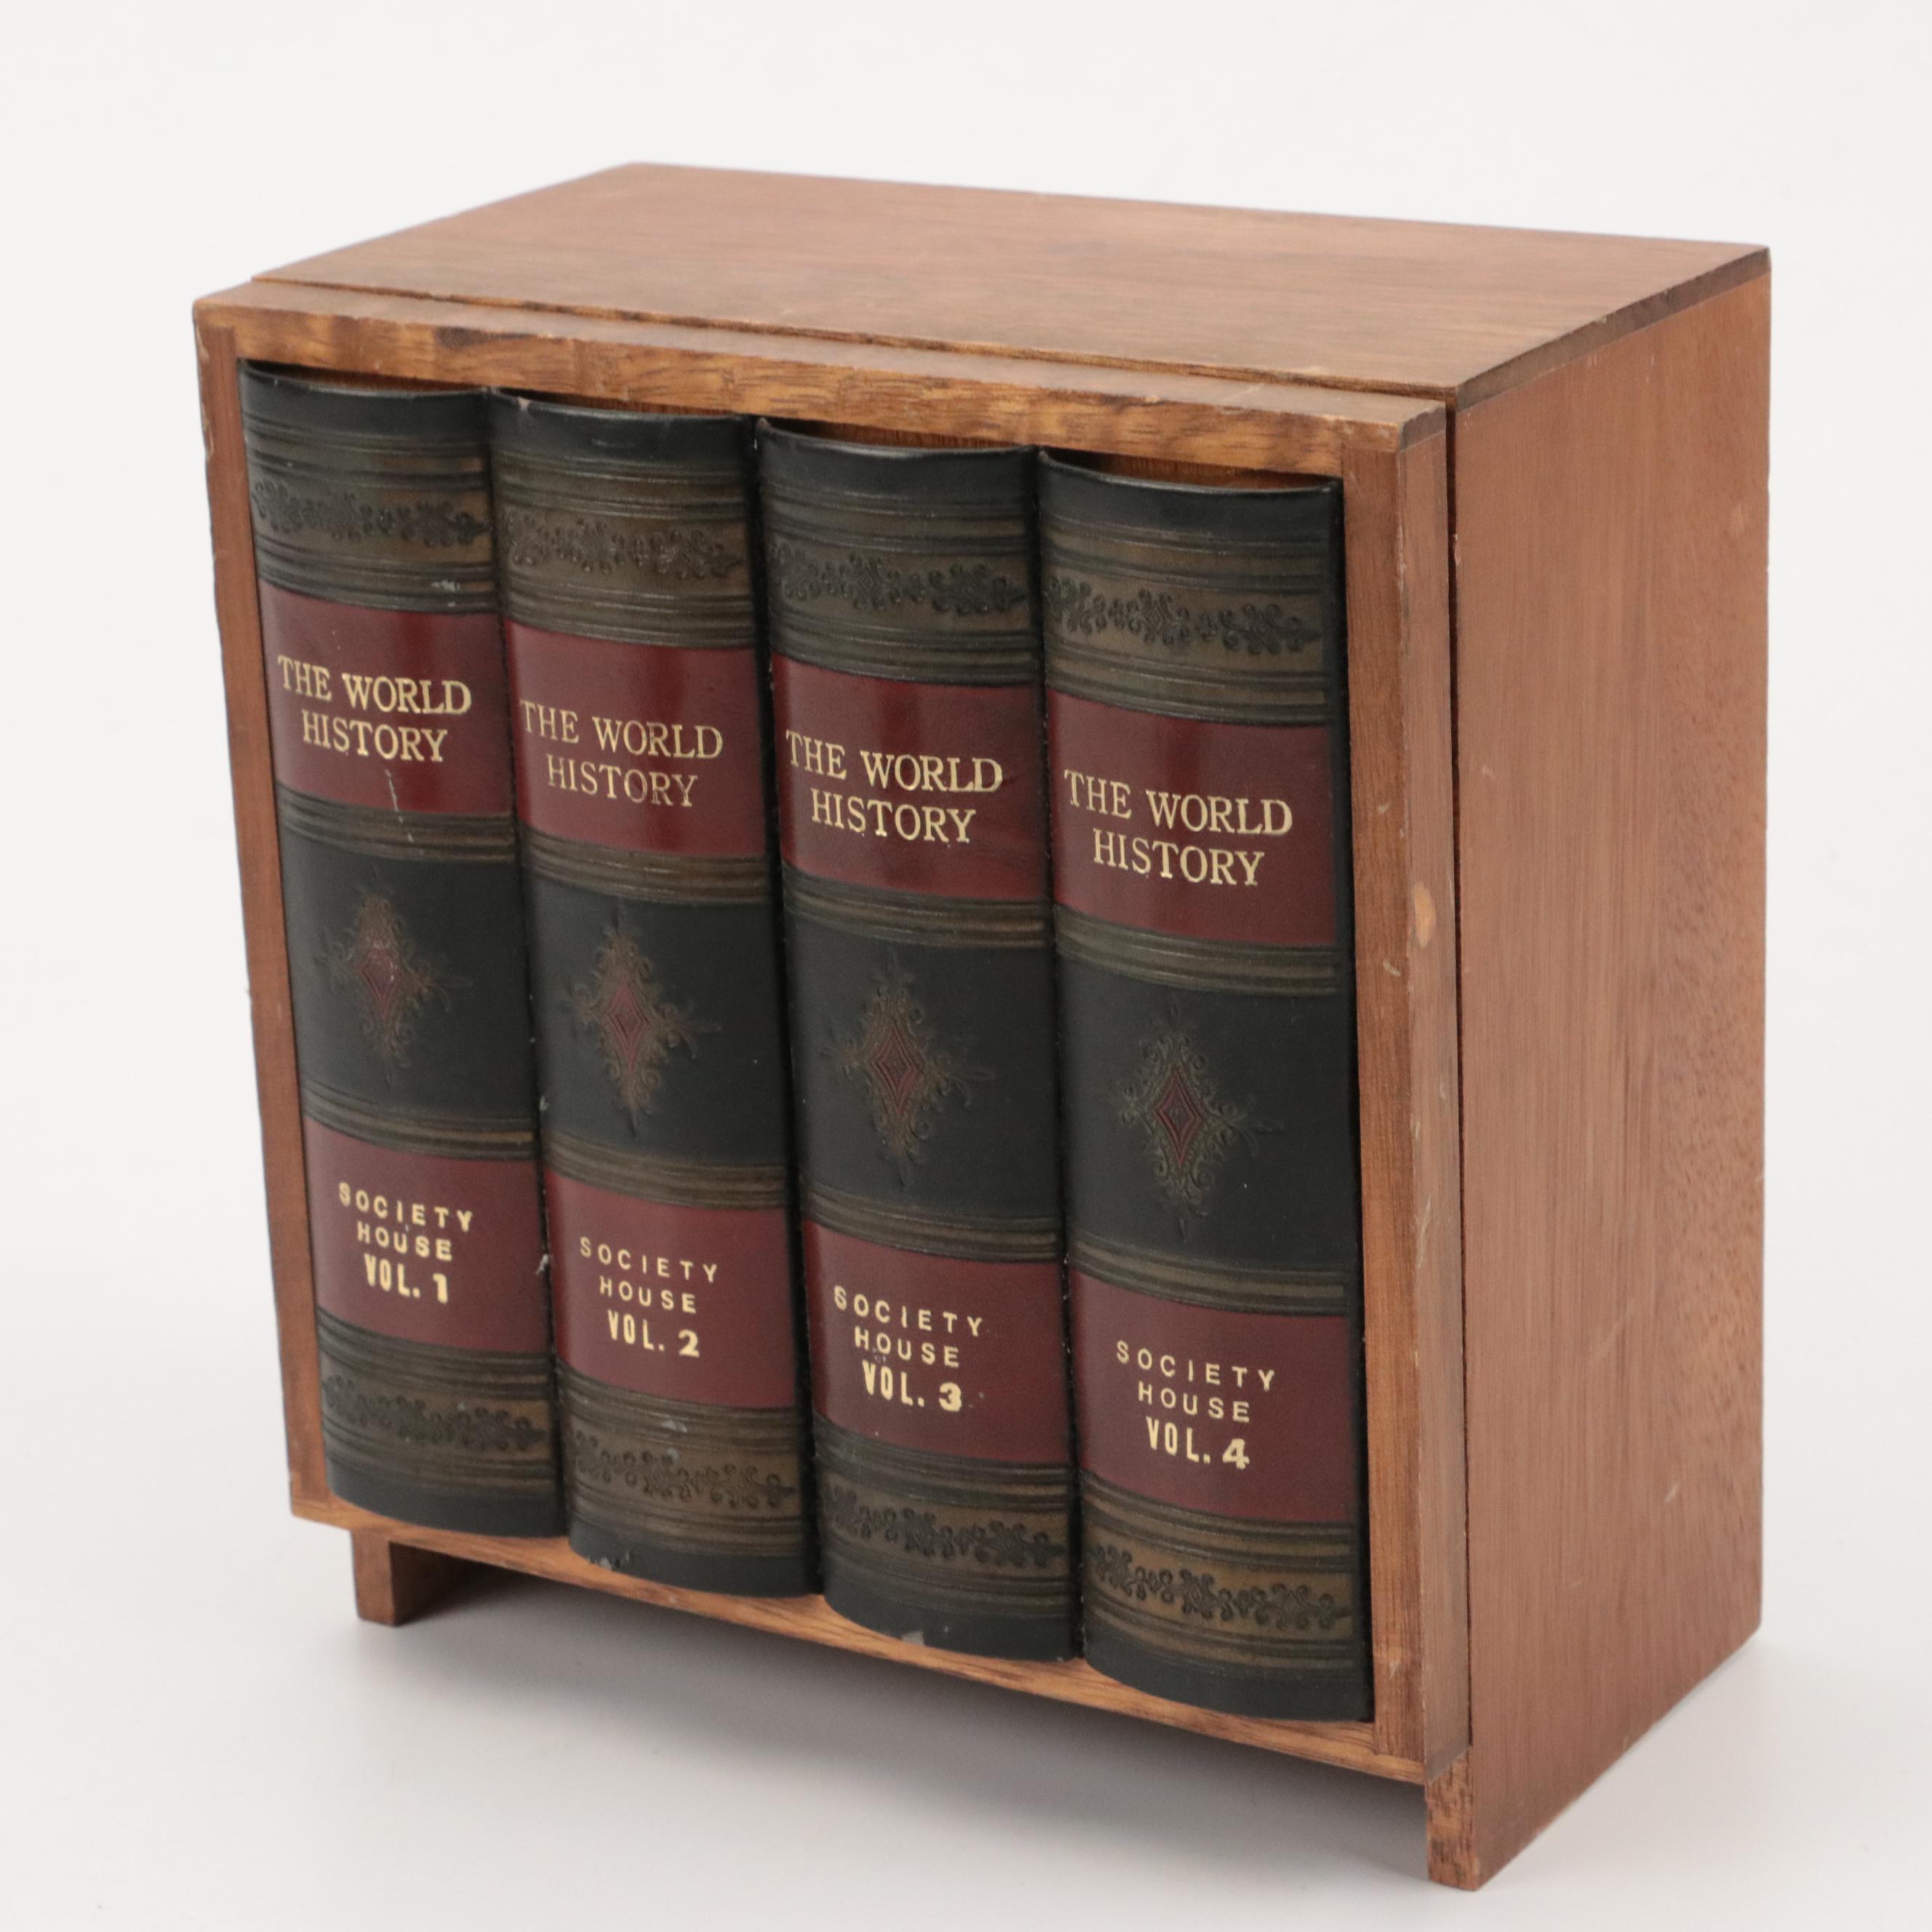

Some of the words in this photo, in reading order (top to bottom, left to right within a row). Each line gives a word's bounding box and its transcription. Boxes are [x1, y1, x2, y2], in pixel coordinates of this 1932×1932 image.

[277, 654, 332, 701] THE
[340, 672, 472, 716] WORLD
[300, 708, 448, 762] HISTORY
[520, 699, 580, 745] THE
[591, 716, 723, 759] WORLD
[546, 754, 698, 807] HISTORY
[786, 730, 847, 781] THE
[859, 749, 1003, 793] WORLD
[810, 787, 976, 845] HISTORY
[1063, 768, 1133, 820] THE
[1145, 789, 1293, 836] WORLD
[1093, 827, 1265, 887] HISTORY
[338, 1181, 473, 1232] SOCIETY
[356, 1220, 453, 1262] HOUSE
[579, 1236, 718, 1284] SOCIETY
[363, 1252, 421, 1299] VOL.
[432, 1272, 449, 1304] 1
[599, 1275, 697, 1314] HOUSE
[607, 1309, 666, 1352] VOL.
[678, 1328, 700, 1358] 2
[833, 1285, 983, 1337] SOCIETY
[854, 1325, 959, 1368] HOUSE
[1116, 1339, 1275, 1392] SOCIETY
[861, 1359, 925, 1408] VOL.
[938, 1381, 962, 1413] 3
[1138, 1380, 1250, 1424] HOUSE
[1145, 1416, 1211, 1464] VOL.
[1221, 1438, 1250, 1470] 4
